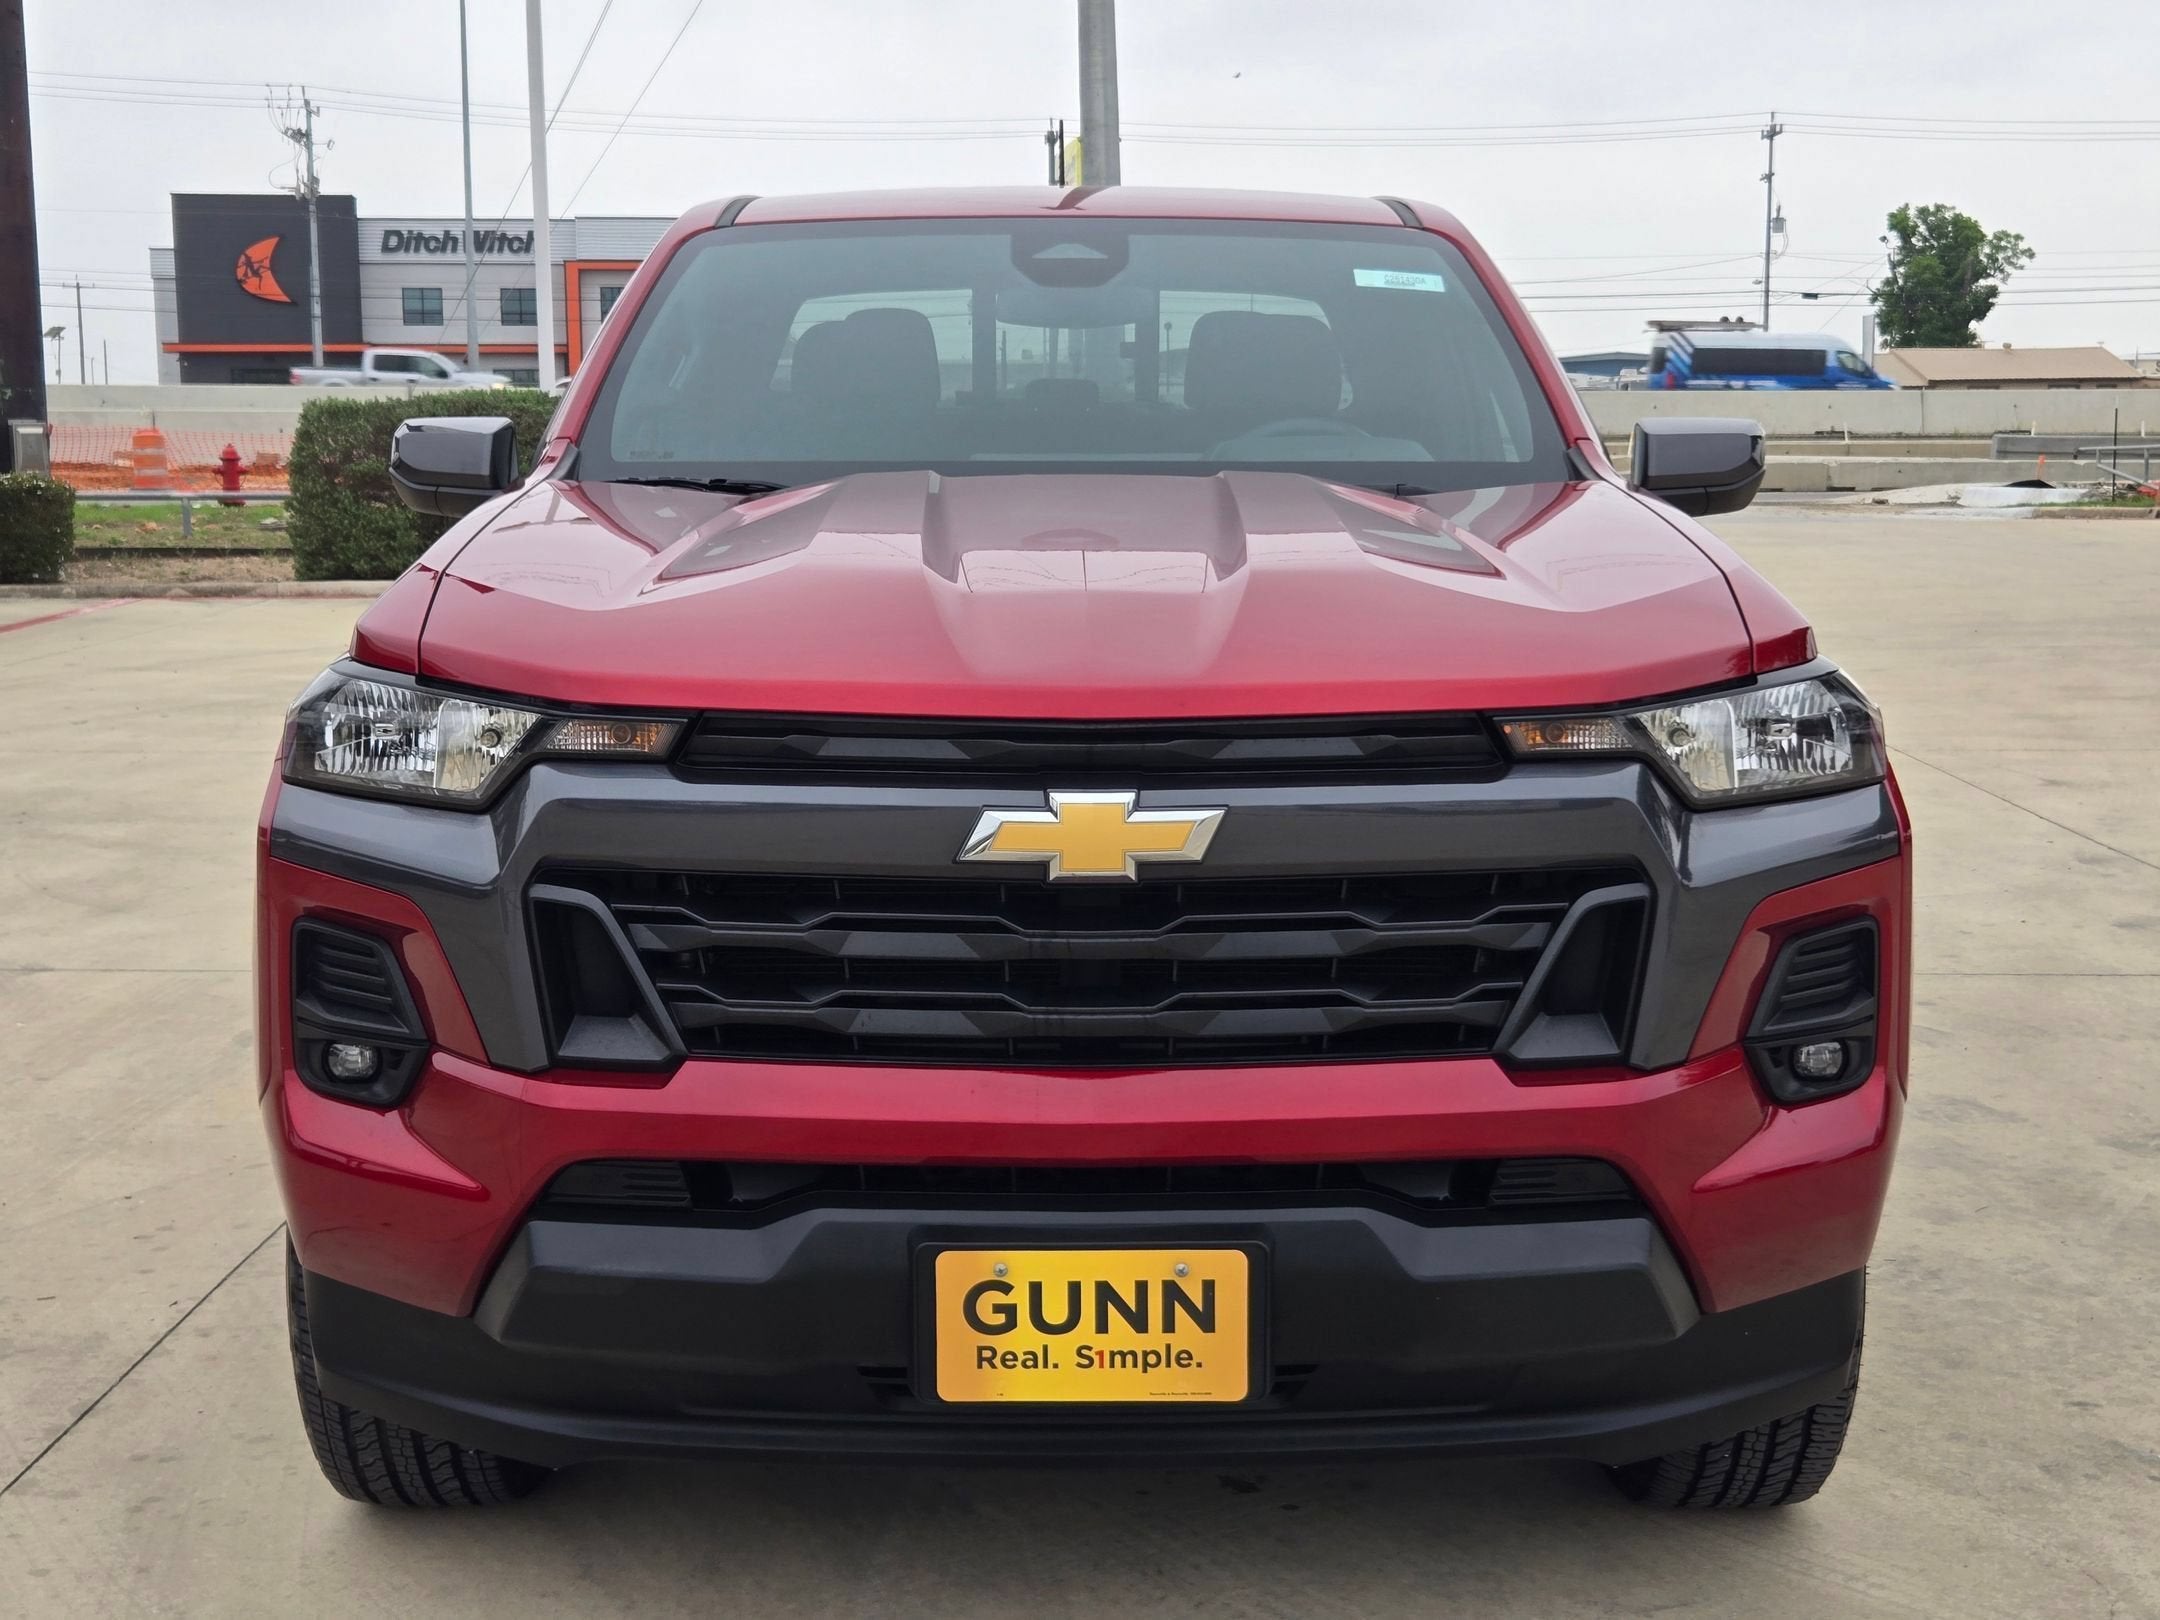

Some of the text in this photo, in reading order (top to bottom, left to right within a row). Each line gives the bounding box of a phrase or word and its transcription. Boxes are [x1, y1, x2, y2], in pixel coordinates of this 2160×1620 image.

[381, 229, 459, 254] Ditch
[962, 1278, 1216, 1336] GUNN
[976, 1344, 1059, 1370] Real.
